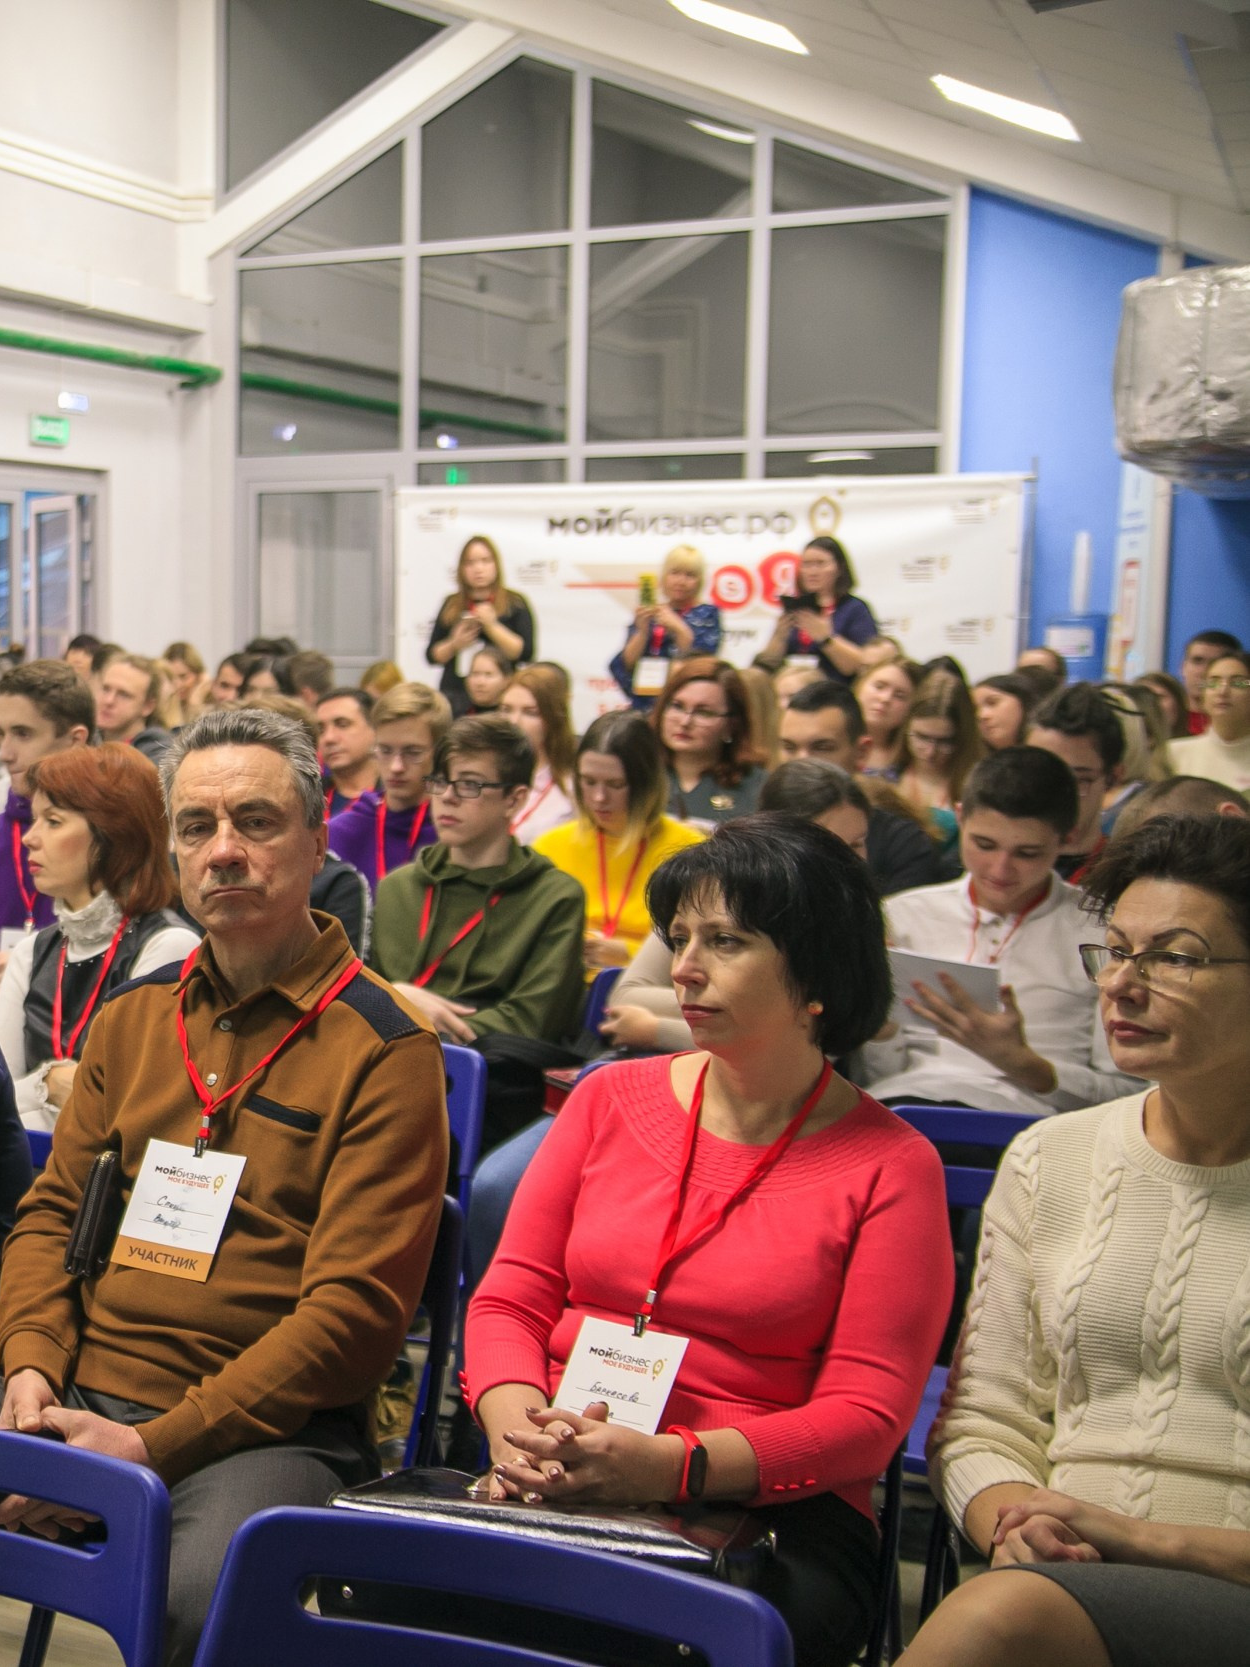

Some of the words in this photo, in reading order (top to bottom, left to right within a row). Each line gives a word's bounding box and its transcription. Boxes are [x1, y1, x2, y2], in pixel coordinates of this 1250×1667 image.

[547, 507, 796, 540] мойбизнес.рф
[154, 1165, 212, 1183] мойбизнес
[128, 1246, 198, 1271] УЧАСТНИК
[589, 1346, 651, 1367] мойбизнес
